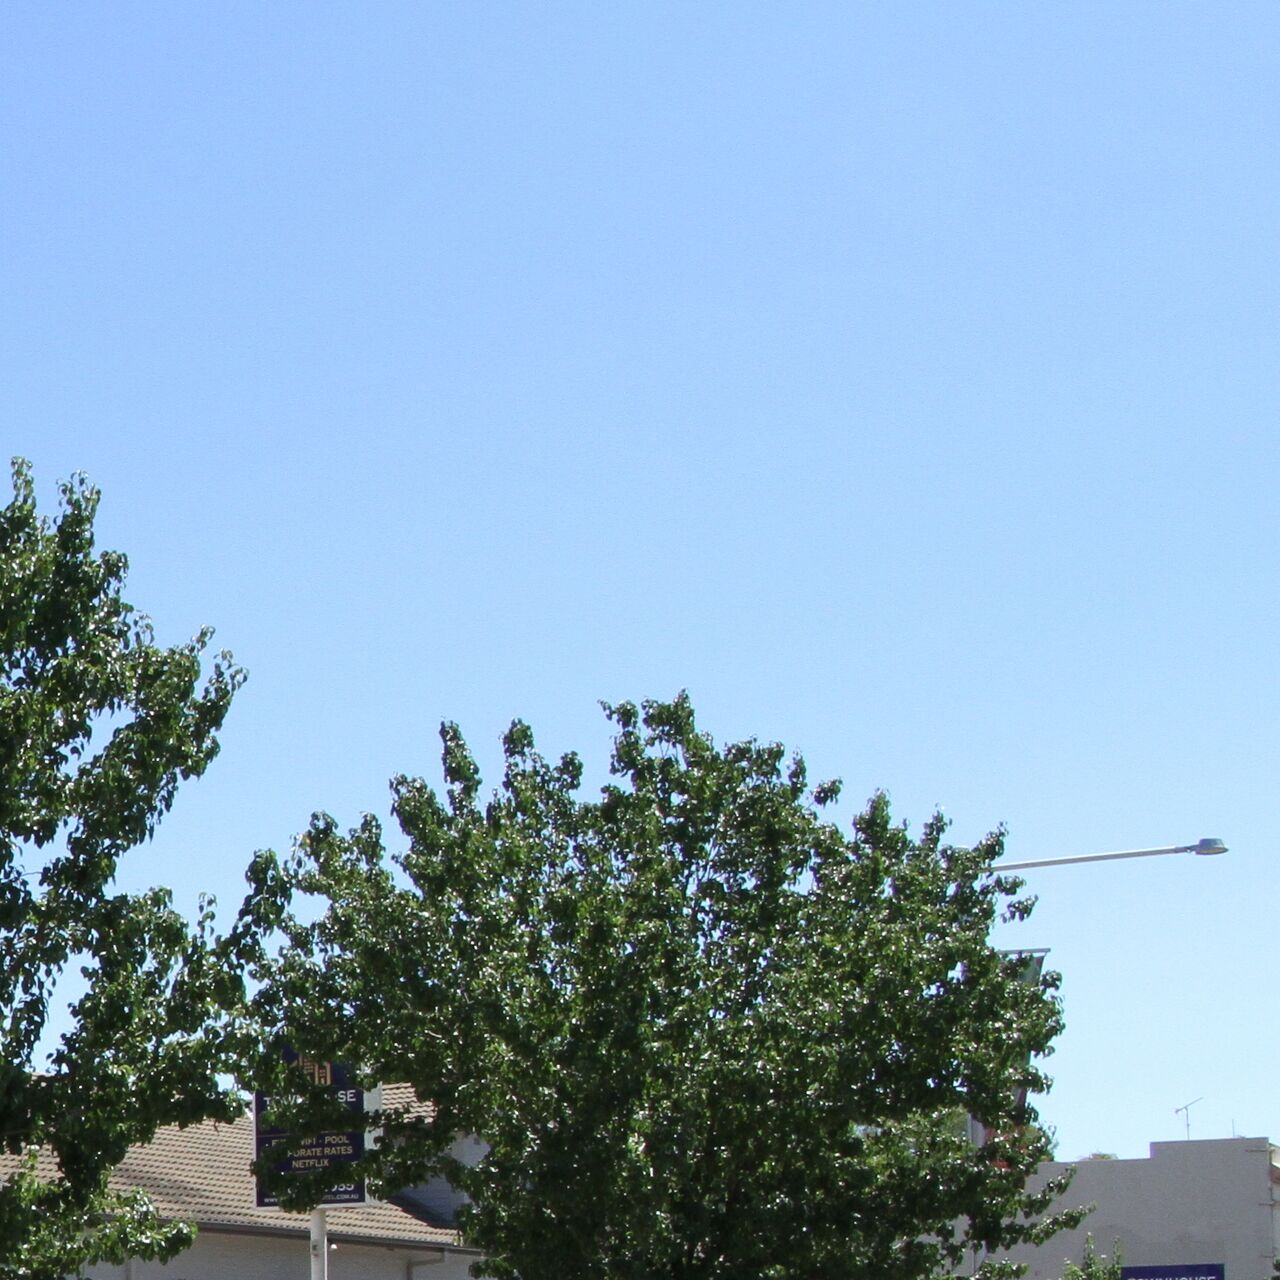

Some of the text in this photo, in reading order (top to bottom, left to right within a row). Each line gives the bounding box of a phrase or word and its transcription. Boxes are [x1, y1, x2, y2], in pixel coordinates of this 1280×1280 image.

[324, 1135, 350, 1144] POOL
[324, 1146, 353, 1156] RATES
[292, 1158, 329, 1169] NETFLIX
